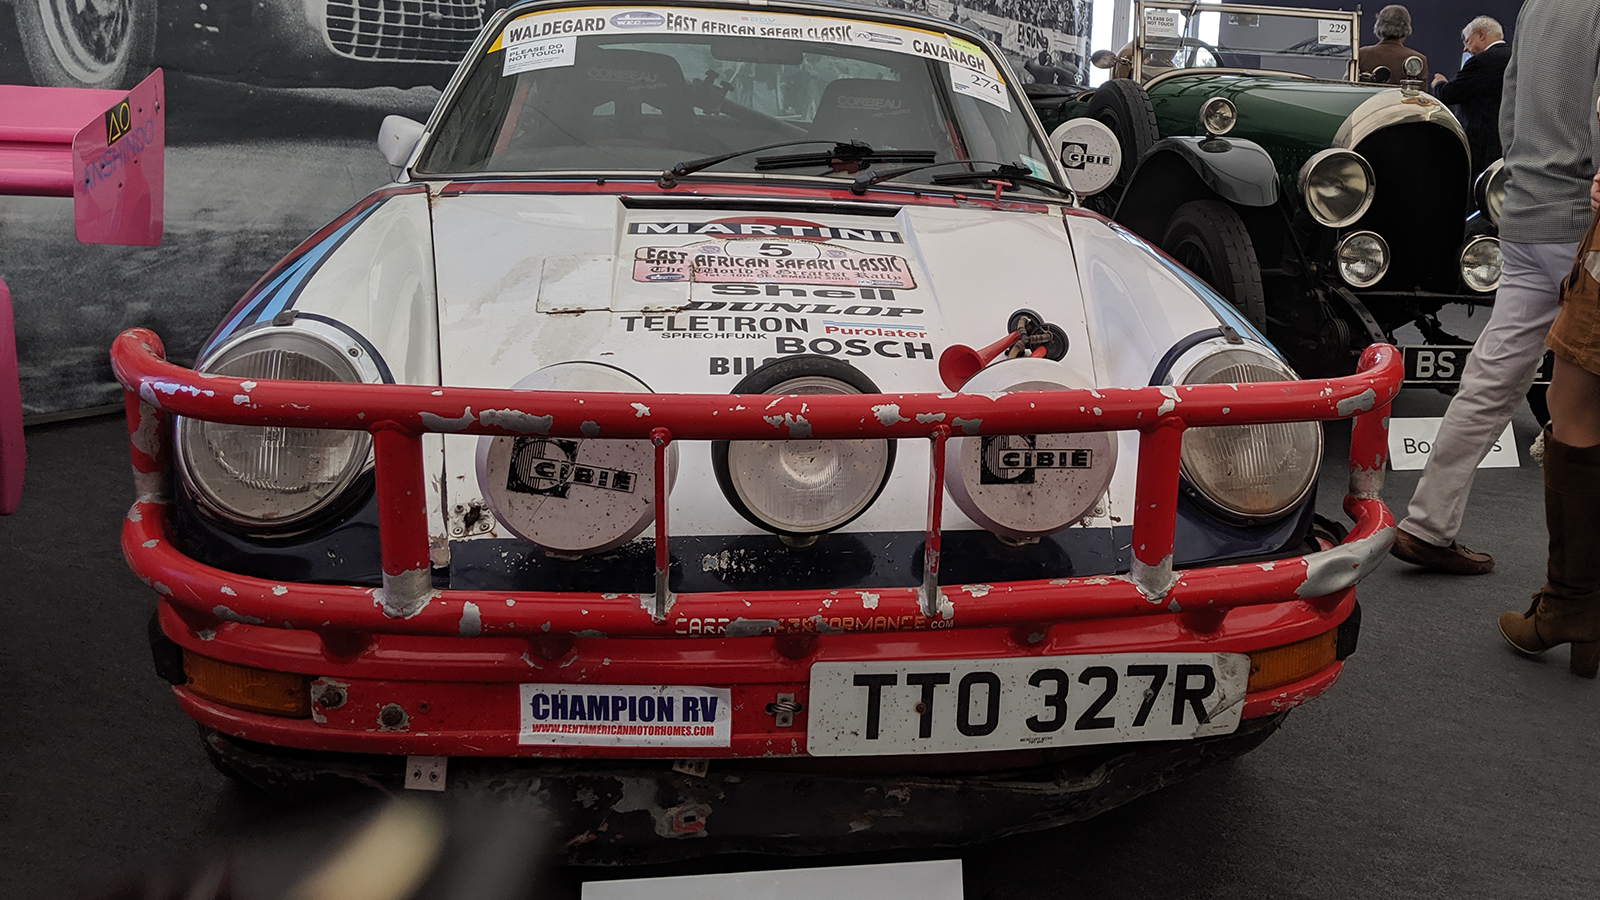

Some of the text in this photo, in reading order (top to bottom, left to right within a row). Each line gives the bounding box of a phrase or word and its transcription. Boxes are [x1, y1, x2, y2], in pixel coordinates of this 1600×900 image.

[510, 18, 606, 43] WALDEGARD
[667, 12, 697, 32] EAST
[702, 21, 755, 36] AFRICAN
[760, 27, 802, 38] SAFARI
[807, 25, 853, 43] CLASSIC
[1329, 23, 1347, 33] 229
[509, 46, 546, 57] PLEASE
[509, 49, 565, 63] NOT TOUCH
[912, 40, 987, 73] CAVANAGH
[971, 74, 1002, 95] 274
[637, 223, 896, 243] MARTINI
[645, 247, 689, 266] EAST
[694, 255, 770, 268] AFRICAN
[775, 259, 836, 271] SAFARI
[839, 256, 903, 273] CLASSIC
[758, 243, 793, 257] 5
[711, 284, 896, 301] Shell
[682, 301, 925, 318] DUNLOP
[619, 315, 928, 338] TELETRON Purolater
[661, 332, 768, 340] SPRECHFUNK
[775, 337, 934, 360] BOSCH
[1416, 351, 1456, 378] BS
[531, 693, 719, 723] CHAMPION RV
[852, 663, 1217, 741] TTO 327R
[532, 723, 715, 737] WWW.RENTAMERICANMOTORHOMES.COM
